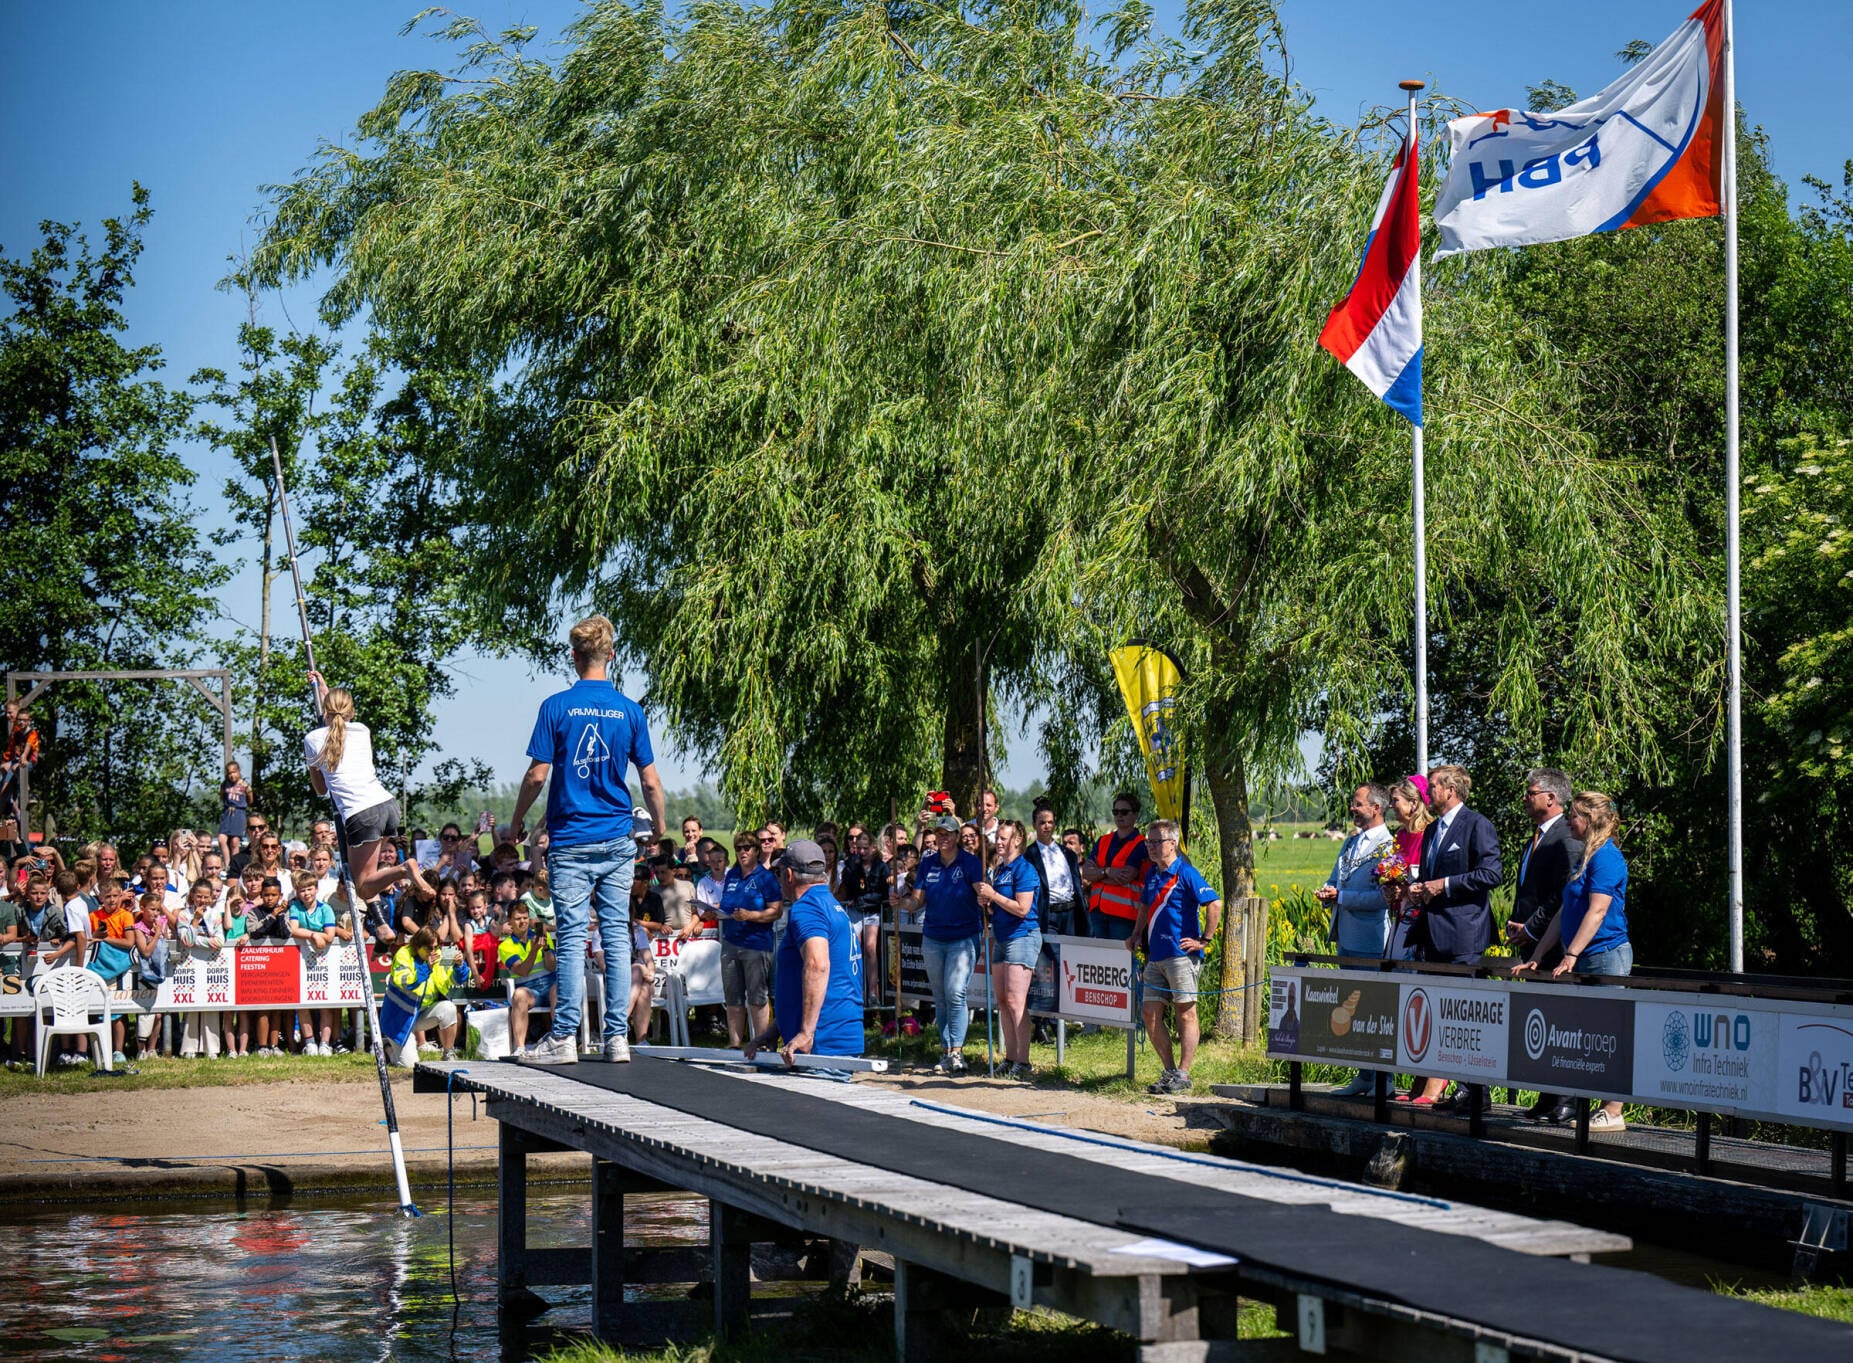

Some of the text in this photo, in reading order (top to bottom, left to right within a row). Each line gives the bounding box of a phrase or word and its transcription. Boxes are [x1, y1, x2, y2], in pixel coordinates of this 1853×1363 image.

[567, 707, 625, 720] VRIJWILLIGER
[173, 967, 196, 975] DORPS
[206, 967, 229, 975] DORPS
[306, 972, 329, 981] HUIS
[339, 972, 362, 981] HUIS
[1076, 963, 1128, 987] TERBERG
[173, 975, 196, 984] HUIS
[206, 974, 229, 984] HUIS
[173, 993, 195, 1003] XXL
[207, 992, 229, 1003] XXL
[306, 990, 328, 1000] XXL
[339, 990, 361, 1000] XXL
[1084, 989, 1118, 1005] BENSCHOP
[1304, 984, 1339, 1004] Kaaswinkel
[1439, 998, 1504, 1025] VAKGARAGE
[1352, 1019, 1365, 1032] van
[1366, 1016, 1377, 1033] der
[1438, 1025, 1482, 1052] VERBREE
[1547, 1024, 1617, 1058] Avant groep
[1692, 1052, 1750, 1079] Infra Techniek
[1799, 1050, 1838, 1106] B&V
